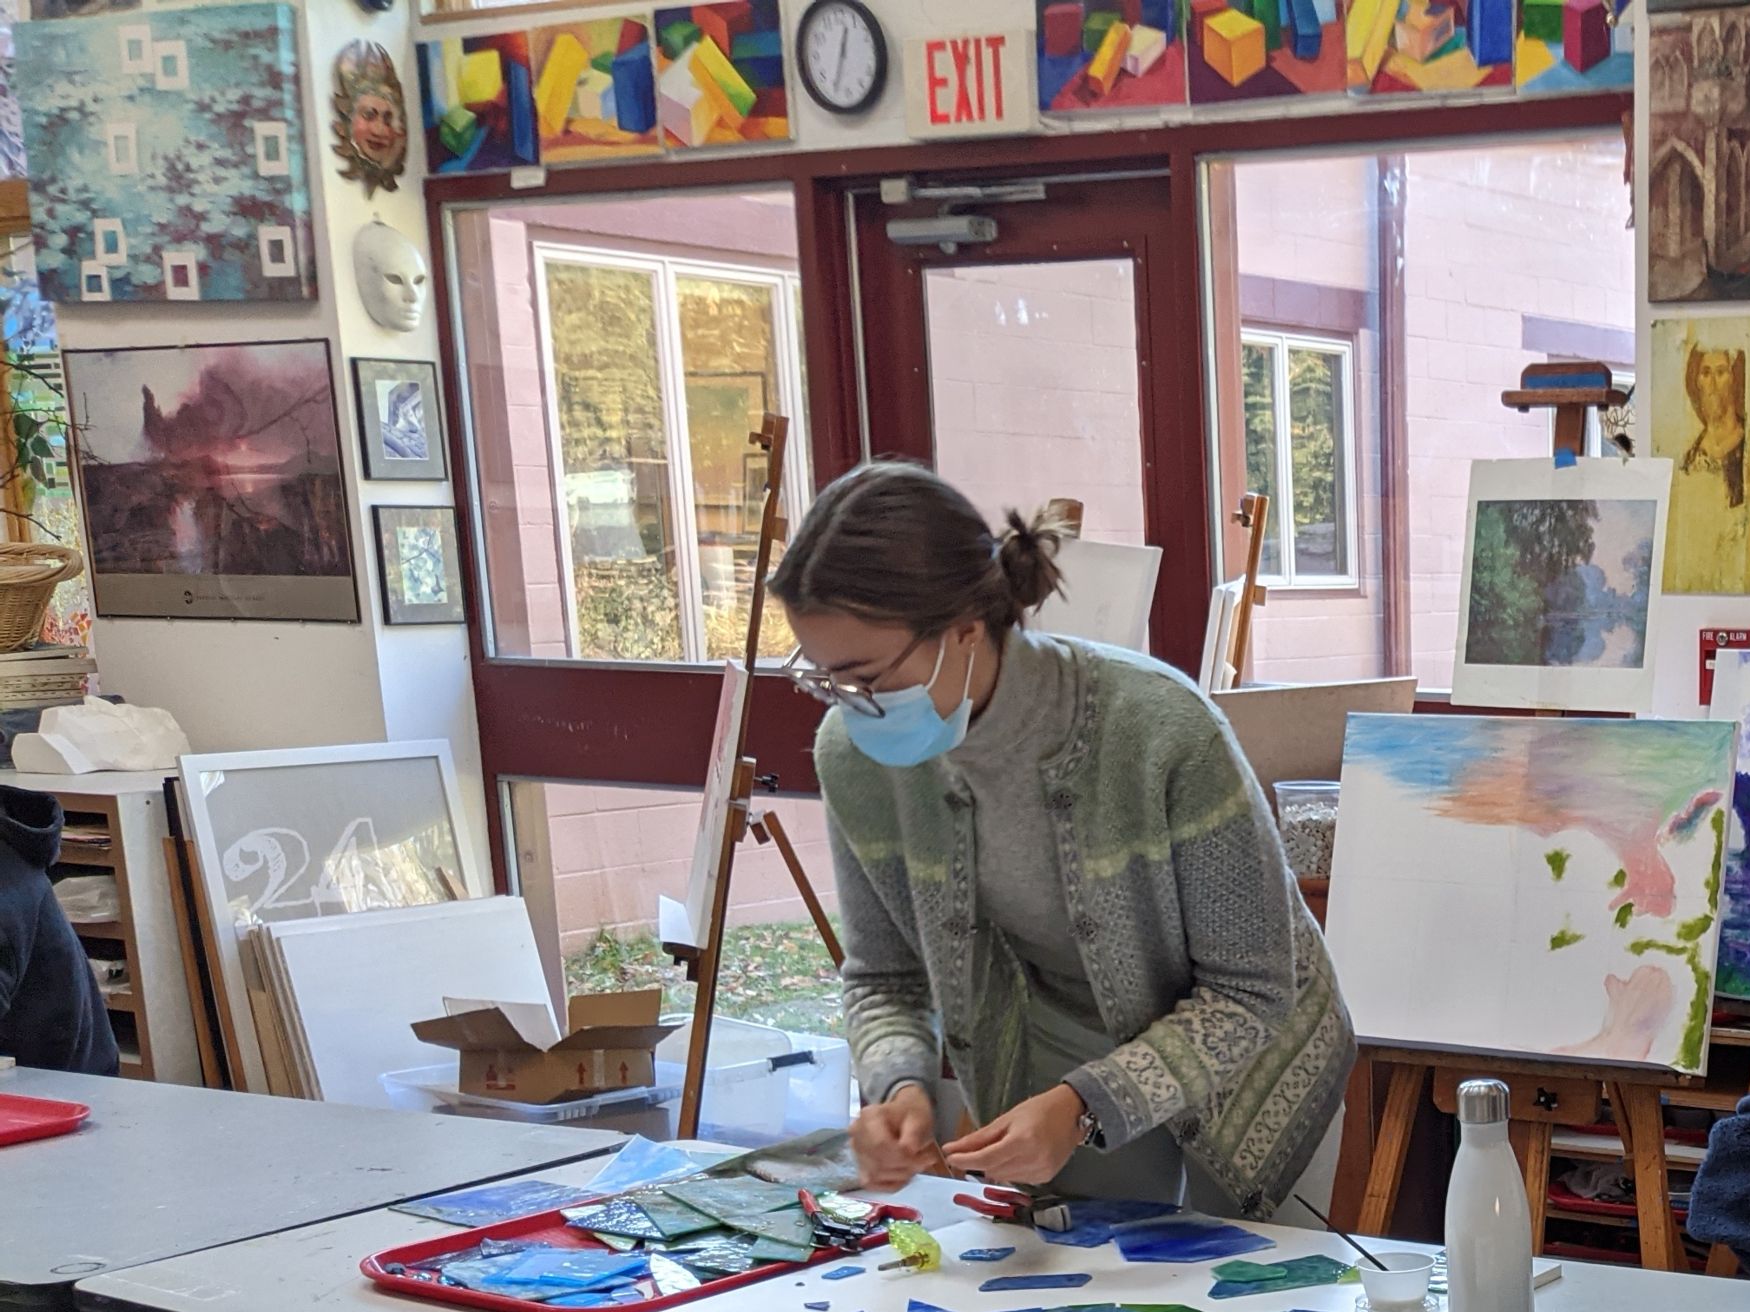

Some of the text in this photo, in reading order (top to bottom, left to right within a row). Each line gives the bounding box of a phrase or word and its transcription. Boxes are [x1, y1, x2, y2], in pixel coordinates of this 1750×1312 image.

[926, 35, 1005, 123] EXIT
[1702, 631, 1748, 642] FIRE ALARM
